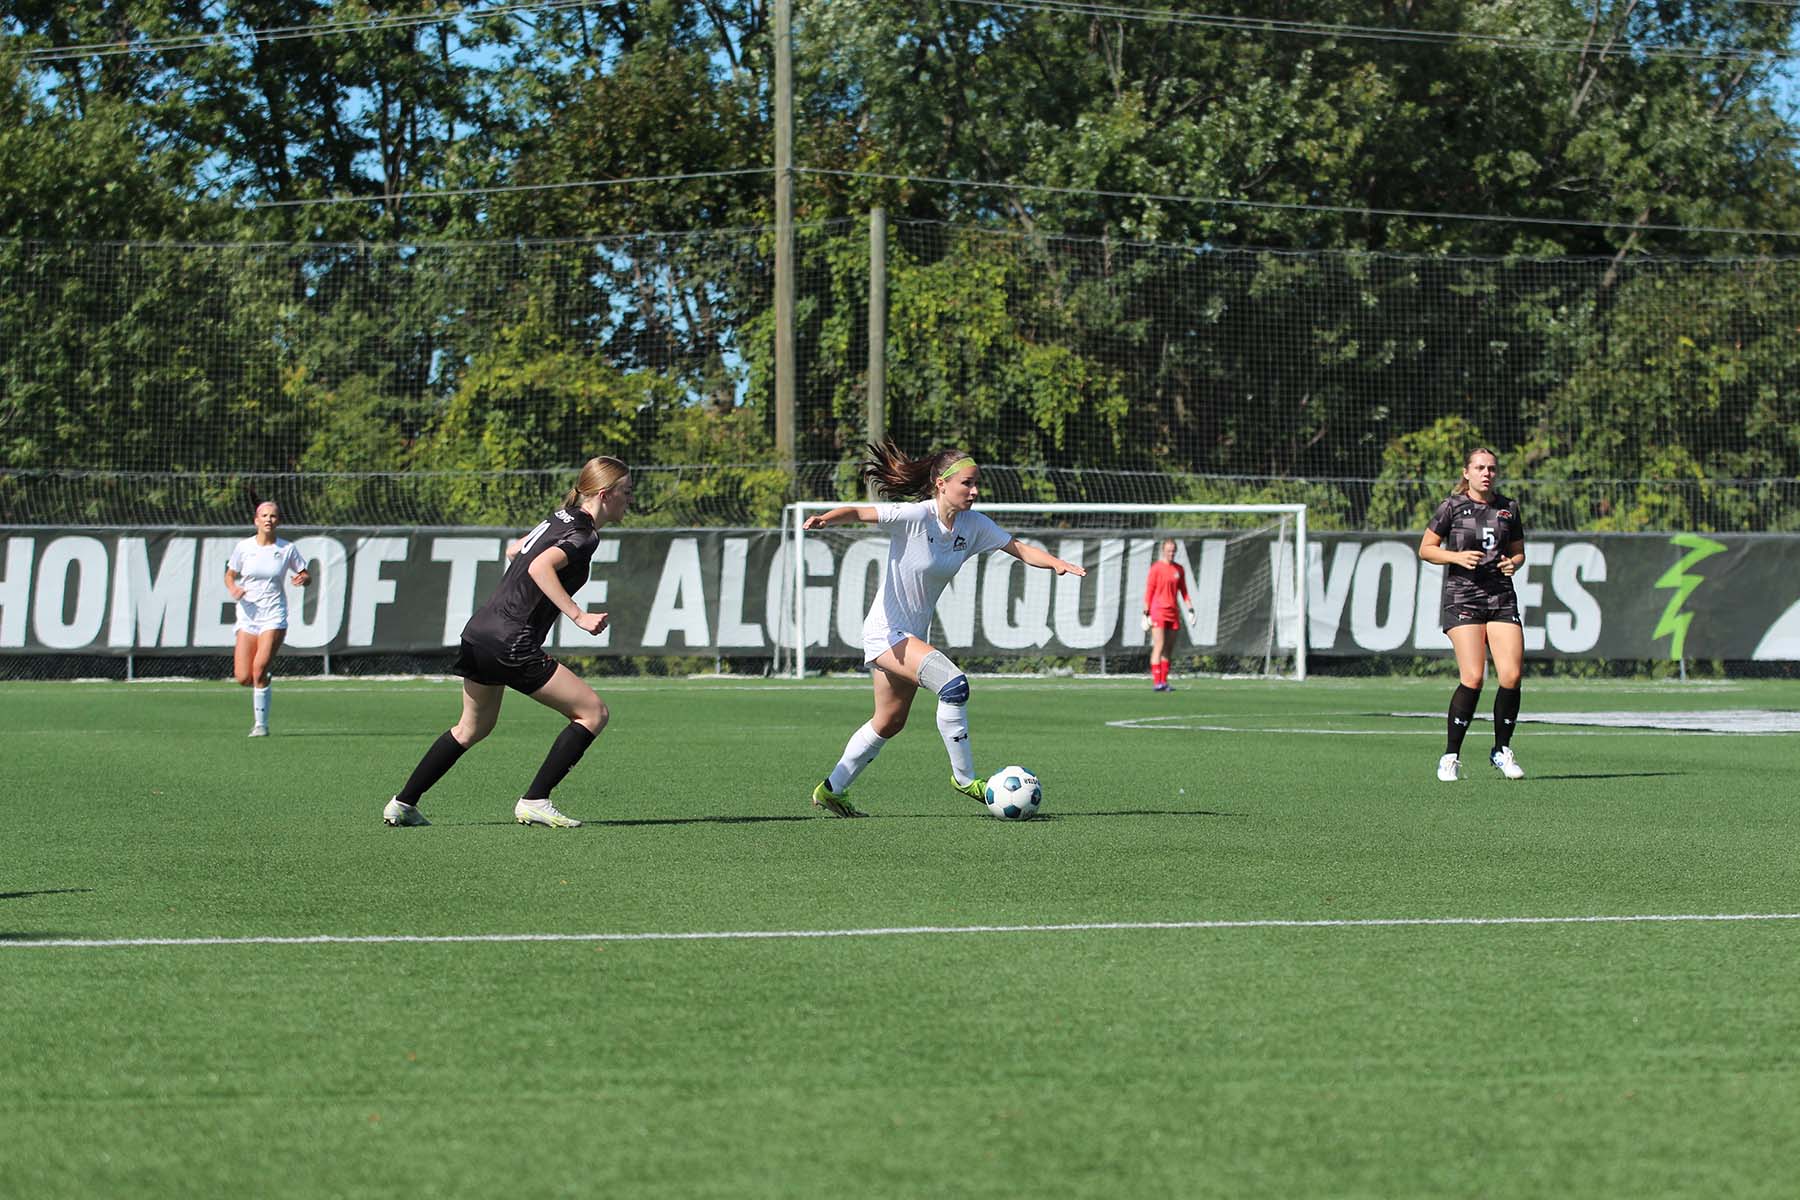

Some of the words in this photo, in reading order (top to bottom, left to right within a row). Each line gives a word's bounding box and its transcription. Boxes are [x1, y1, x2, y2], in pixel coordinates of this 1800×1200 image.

[1482, 527, 1496, 550] 5
[283, 535, 409, 649] OF
[431, 537, 621, 648] TE
[641, 537, 1227, 650] ALGONQUIN
[1270, 540, 1608, 653] WOLES
